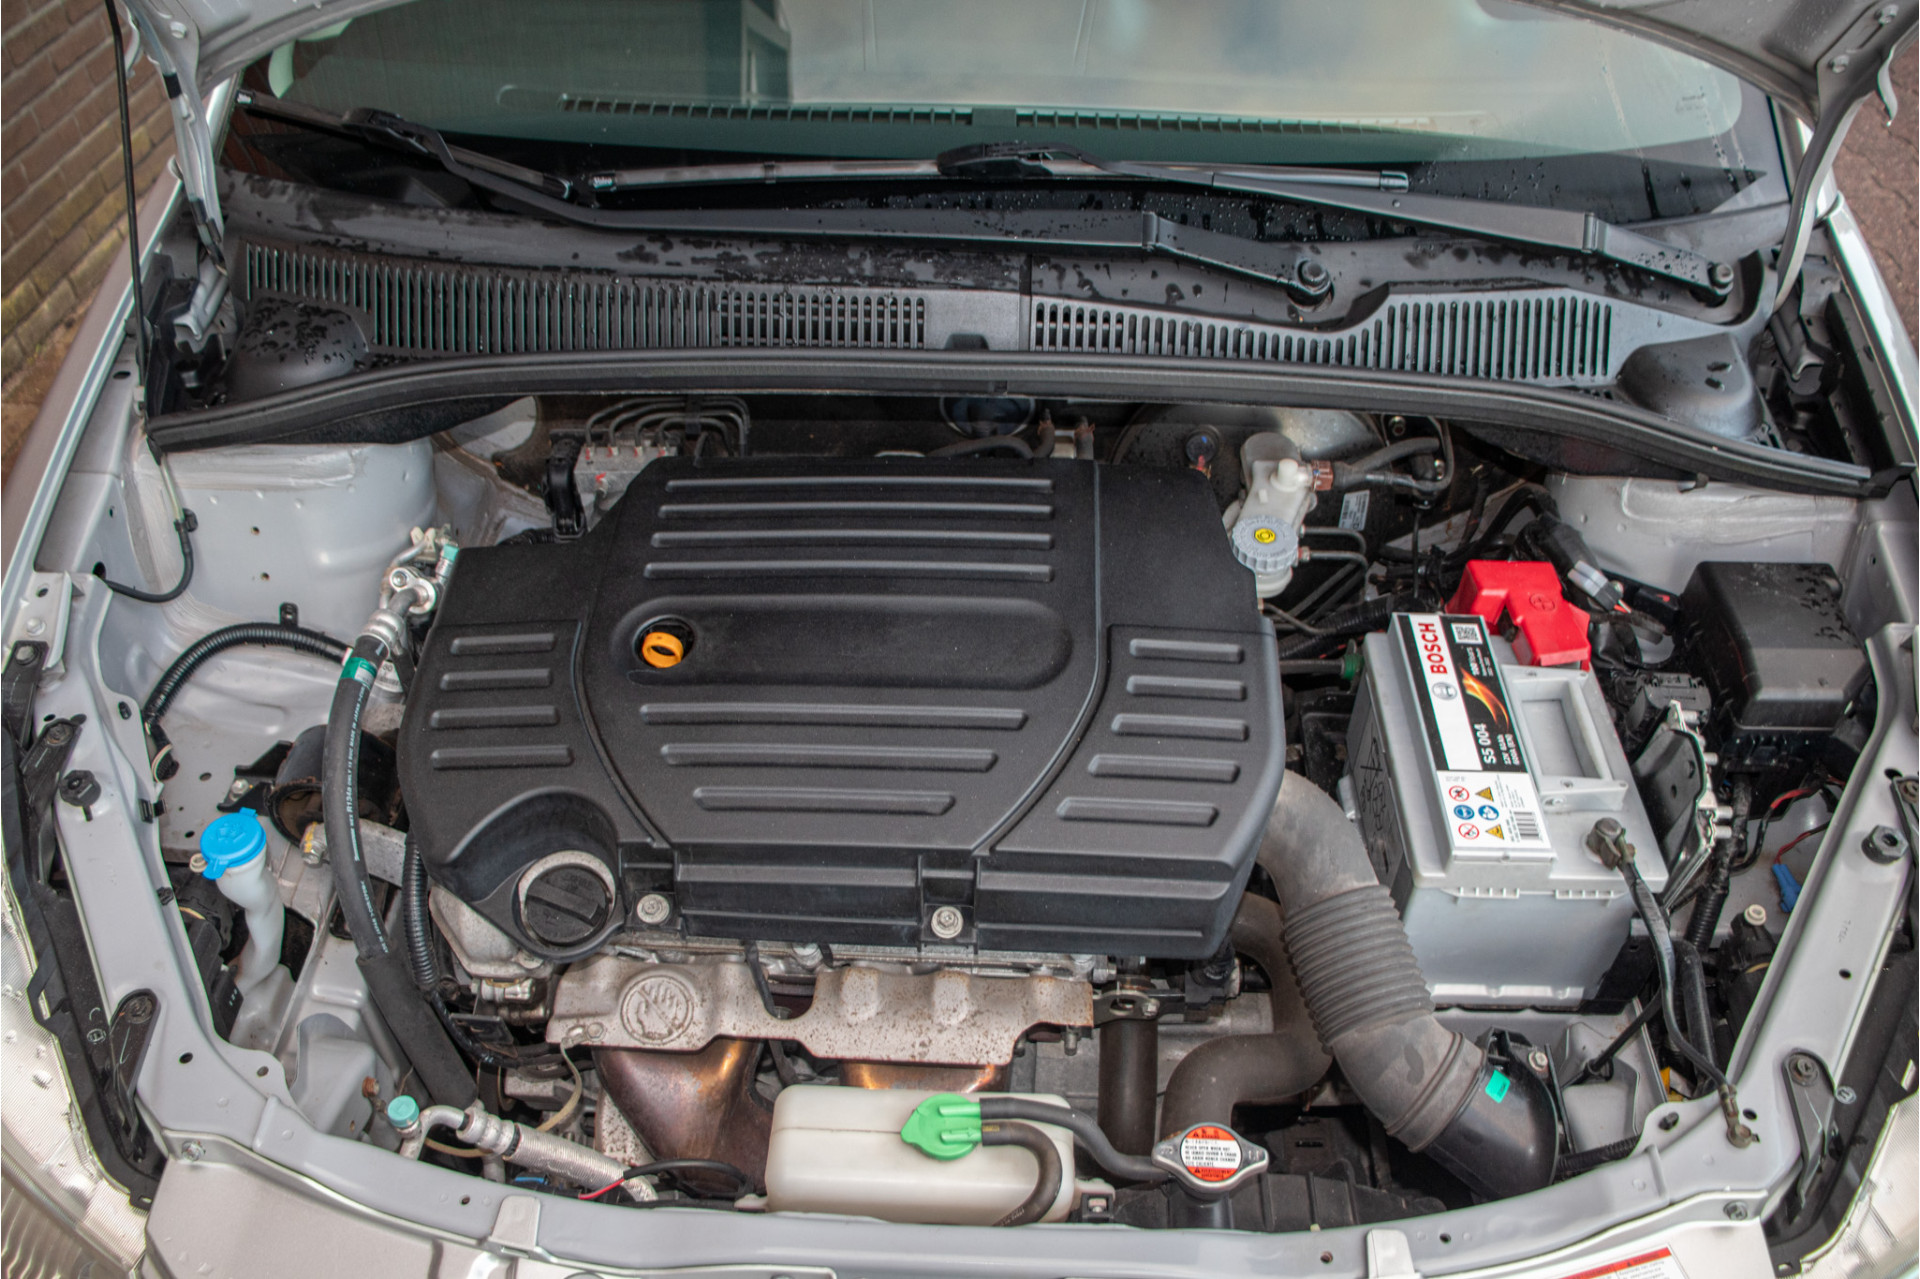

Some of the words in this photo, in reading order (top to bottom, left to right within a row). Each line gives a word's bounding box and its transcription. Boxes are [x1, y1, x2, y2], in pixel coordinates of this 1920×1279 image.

[1418, 623, 1448, 674] BOSCH
[1473, 723, 1491, 746] 004
[1481, 747, 1497, 765] S5
